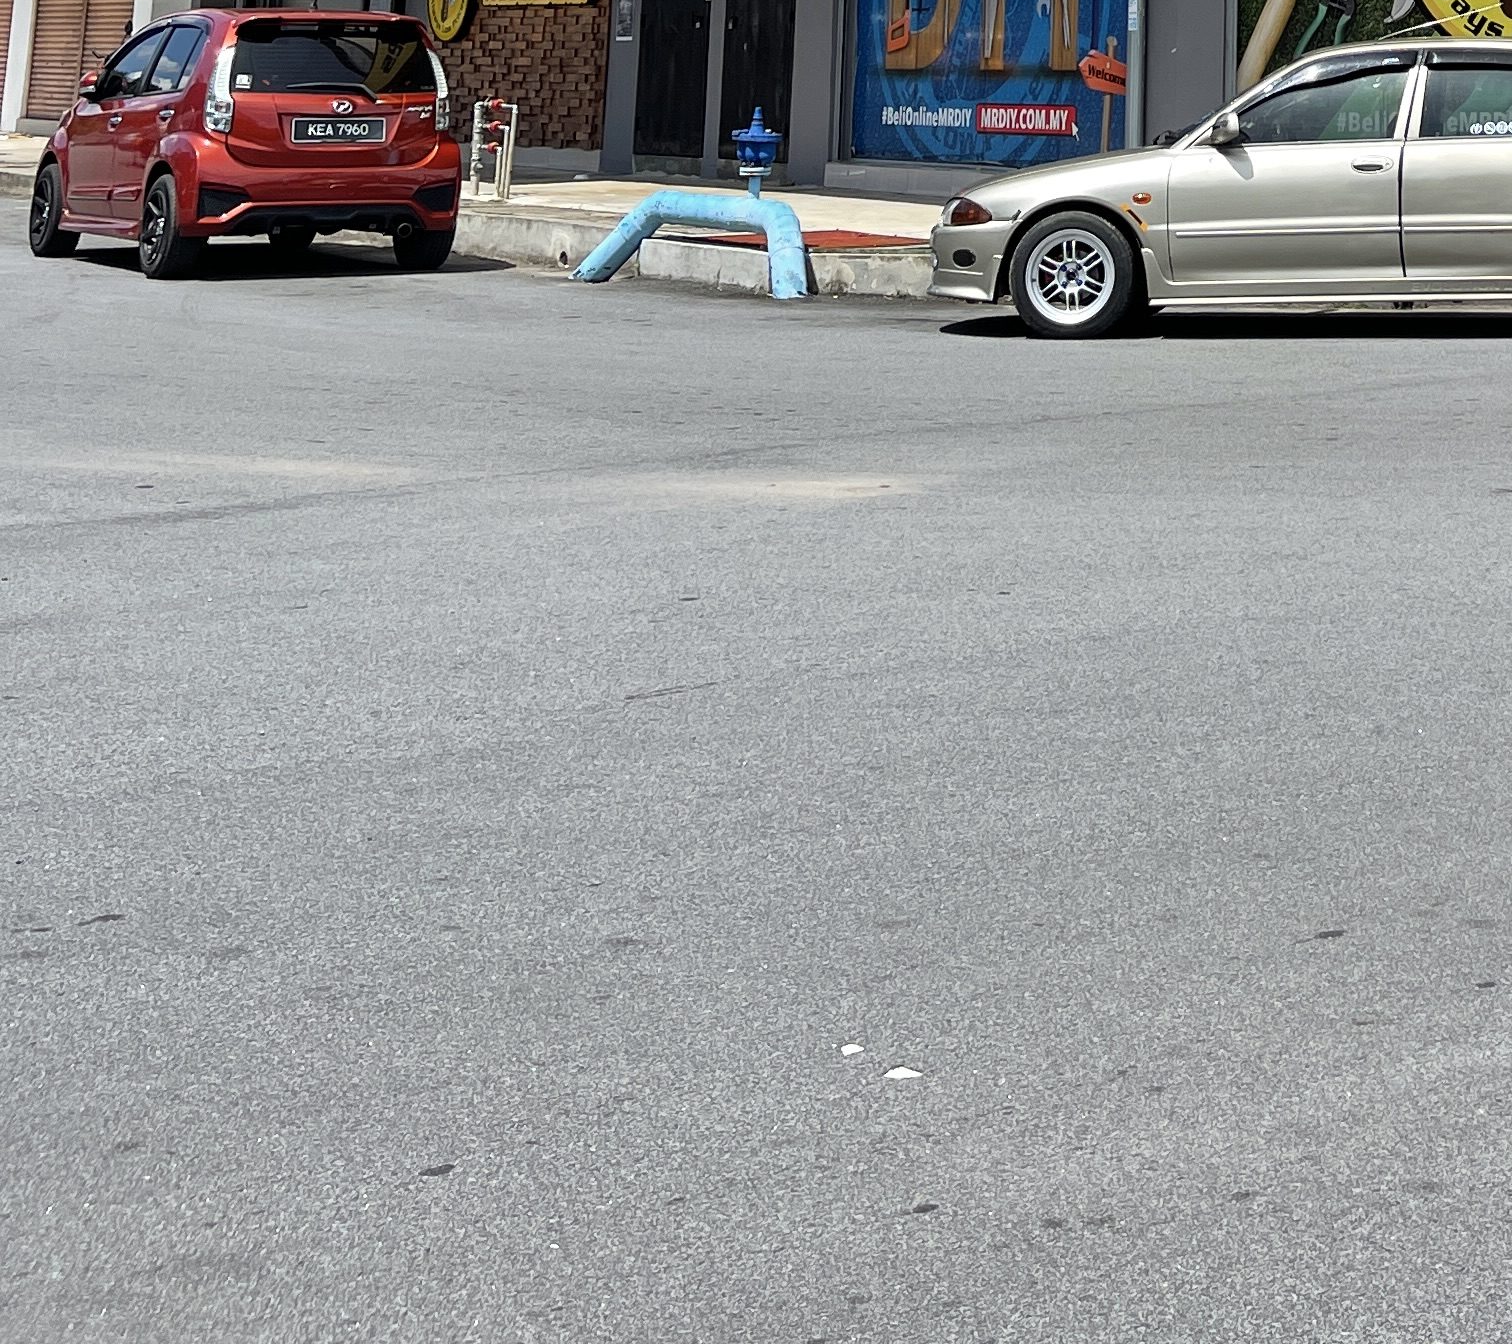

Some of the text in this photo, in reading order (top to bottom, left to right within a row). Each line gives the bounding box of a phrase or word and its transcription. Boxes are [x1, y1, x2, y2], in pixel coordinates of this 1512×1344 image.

[881, 105, 1069, 132] #BeliOnlineMRDIY MRDIY.COM.MY
[307, 123, 369, 136] KEA 7960
